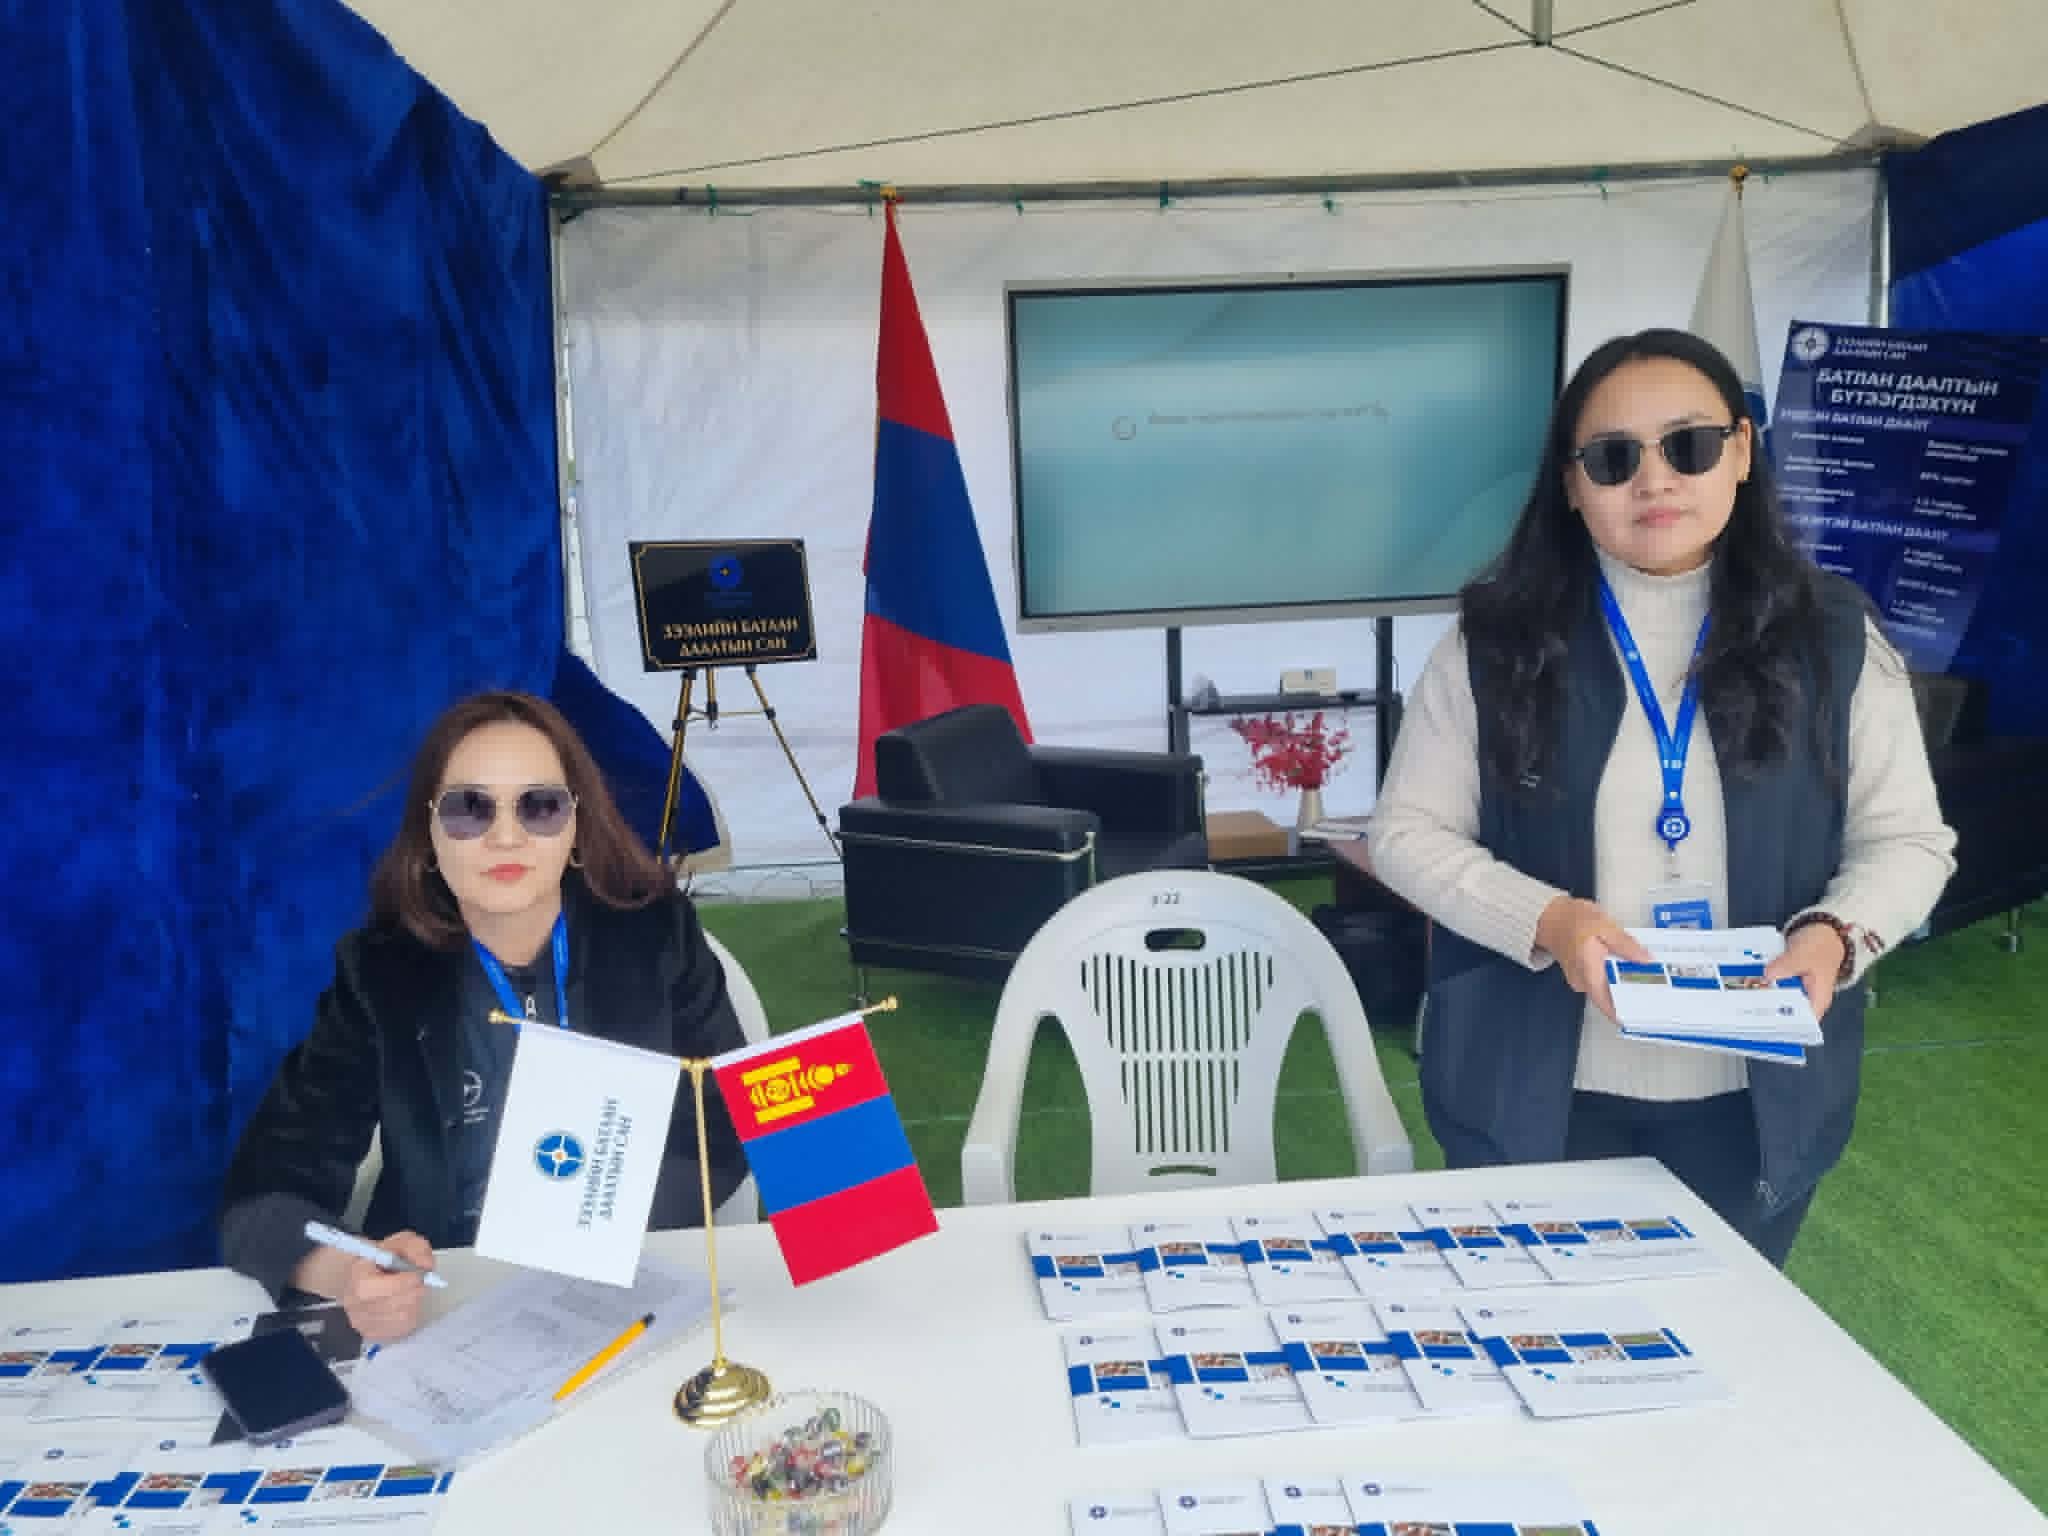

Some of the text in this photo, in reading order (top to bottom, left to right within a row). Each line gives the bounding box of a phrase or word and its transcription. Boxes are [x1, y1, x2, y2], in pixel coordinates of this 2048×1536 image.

[1816, 368, 2000, 396] БАТЛАН ДААЛТЫН
[1831, 388, 1977, 414] БҮТЭЭГДЭХҮҮН
